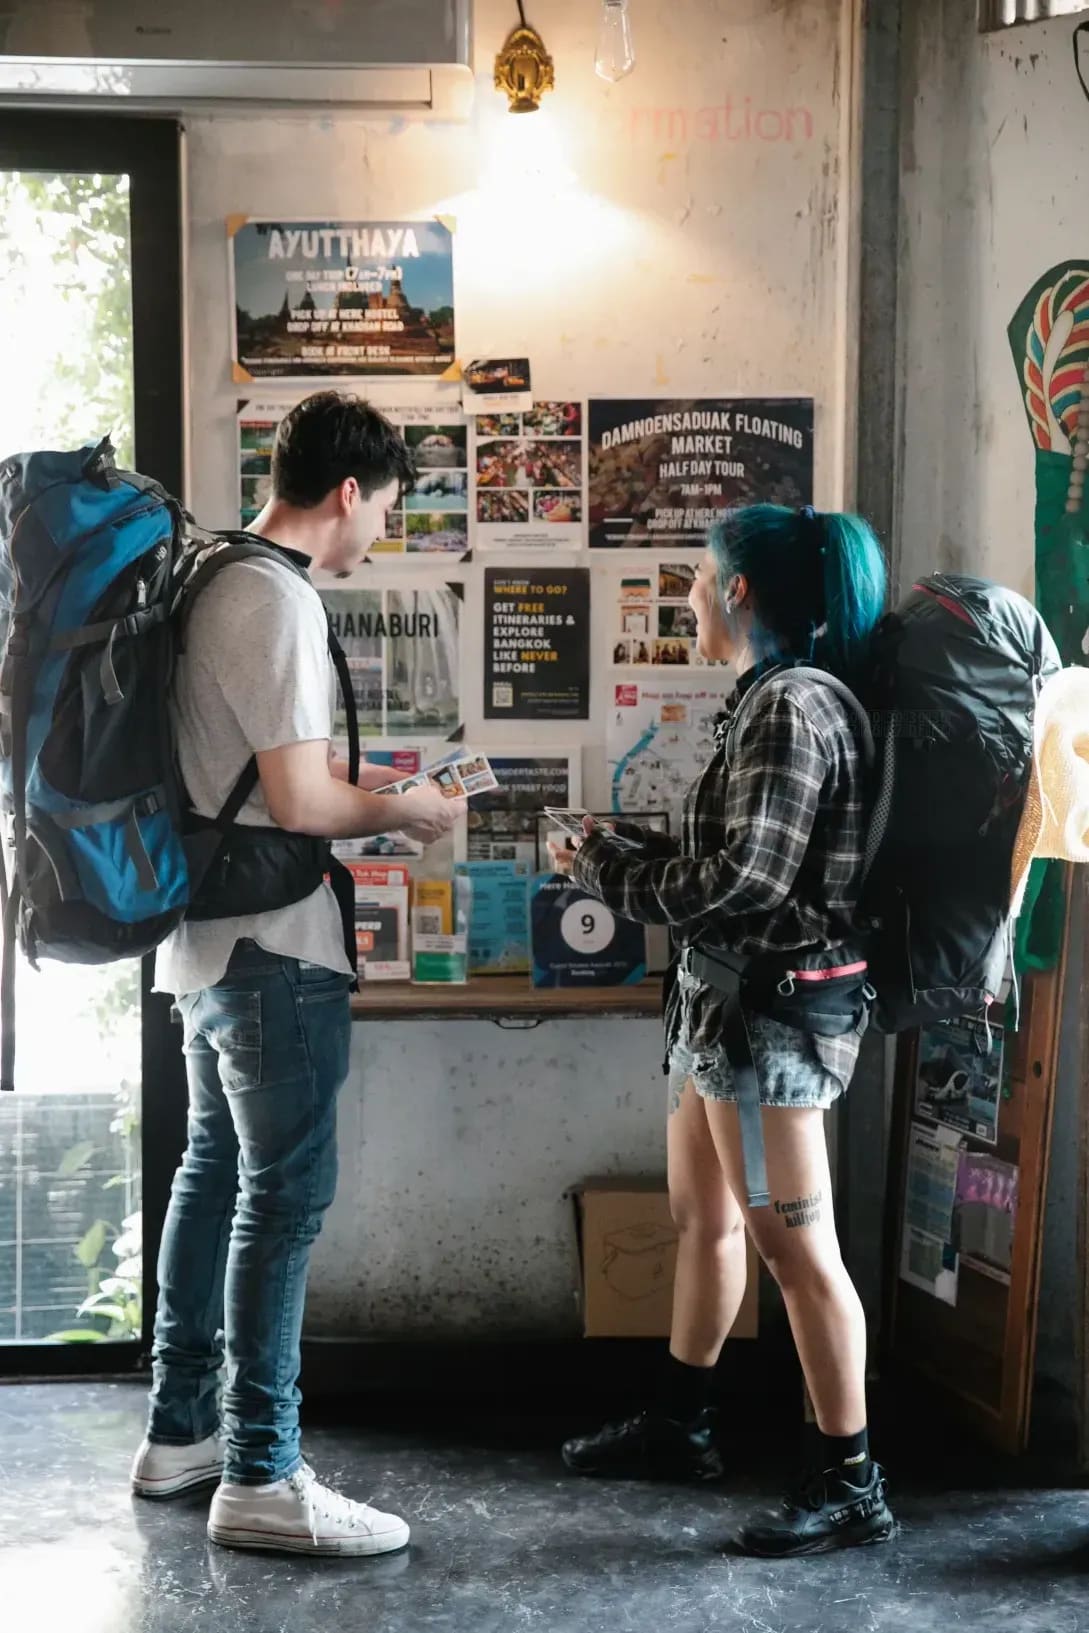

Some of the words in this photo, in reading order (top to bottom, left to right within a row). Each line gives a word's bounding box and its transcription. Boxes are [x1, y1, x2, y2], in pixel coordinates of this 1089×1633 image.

[268, 228, 420, 259] AYUTTHAYA
[601, 411, 732, 451] DAMNOENSADUAK
[735, 413, 804, 449] FLOATING
[671, 436, 733, 455] MARKET
[659, 463, 690, 479] HALF
[690, 461, 713, 476] DAY
[714, 461, 745, 478] TOUR
[494, 585, 528, 594] WHERE
[530, 585, 544, 594] TO
[546, 585, 568, 594] GO?
[493, 602, 516, 613] GET
[518, 602, 545, 613] FREE
[493, 614, 563, 625] ITINERARIES
[565, 615, 576, 626] &
[493, 627, 545, 637] EXPLORE
[493, 639, 551, 649] BANGKOK
[493, 651, 518, 661] LIKE
[520, 651, 559, 661] NEVER
[493, 663, 536, 673] BEFORE
[581, 913, 595, 935] 9
